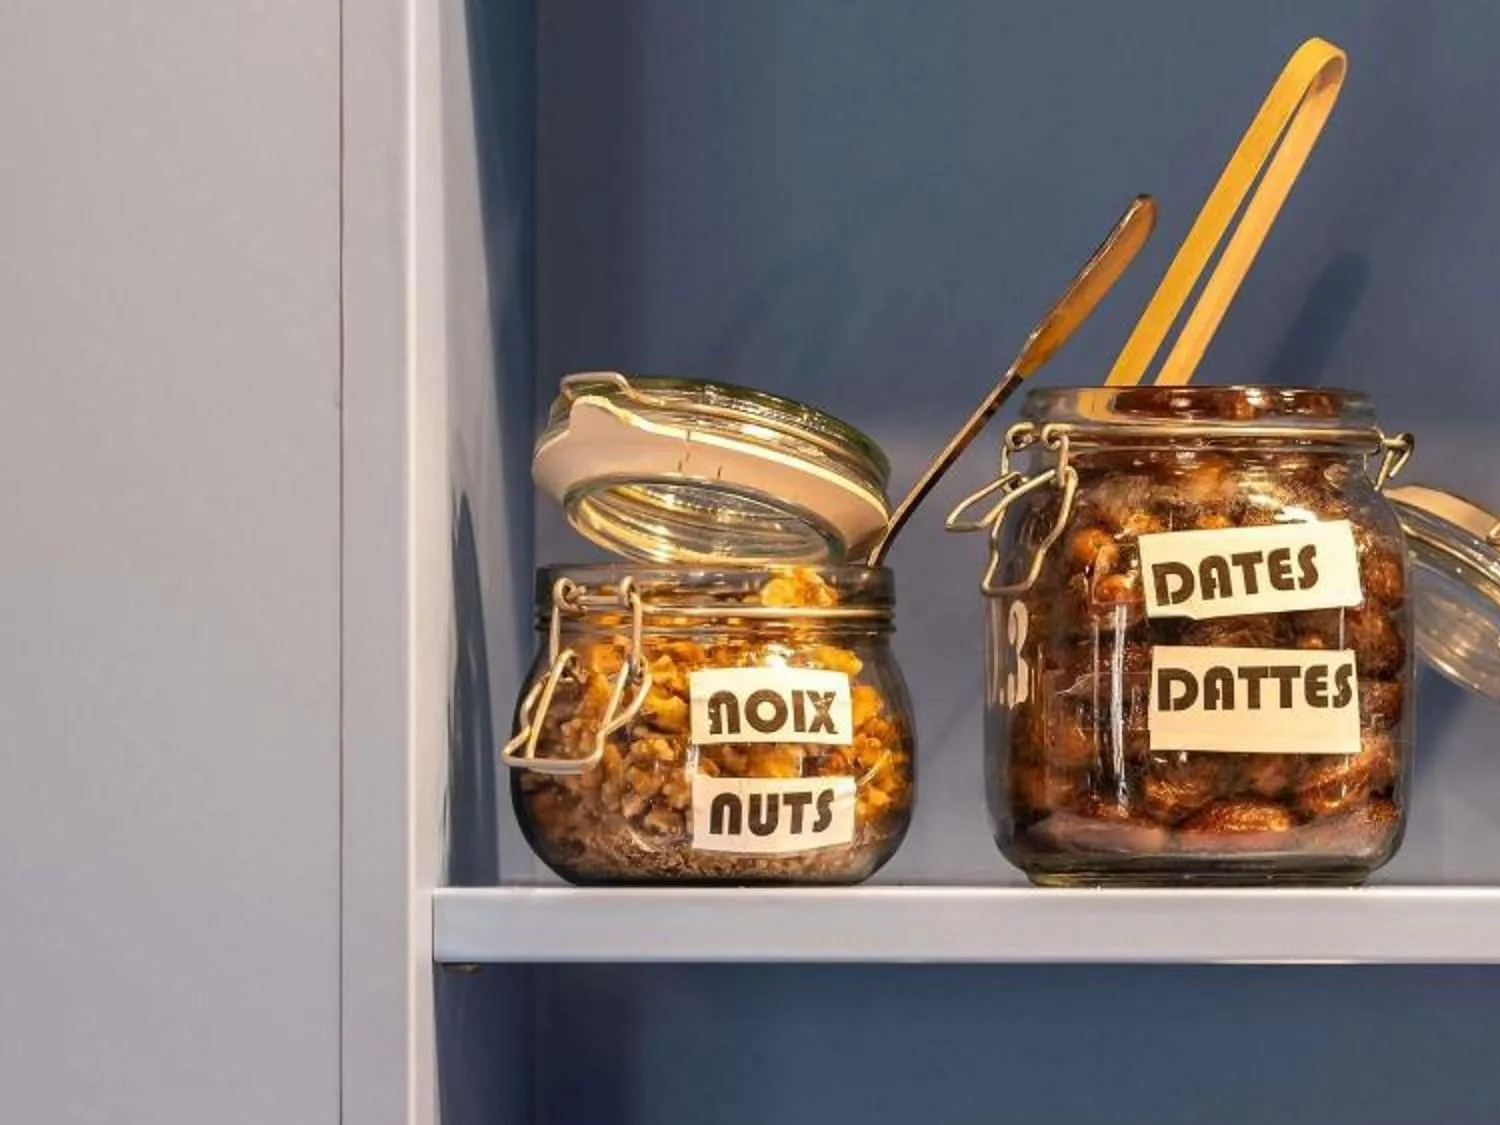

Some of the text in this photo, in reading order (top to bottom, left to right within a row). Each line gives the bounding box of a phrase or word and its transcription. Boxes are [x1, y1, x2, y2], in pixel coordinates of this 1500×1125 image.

[1151, 544, 1319, 607] DATES
[707, 689, 838, 735] NOIX
[1157, 663, 1353, 712] DATTES
[709, 788, 834, 837] NUTS
